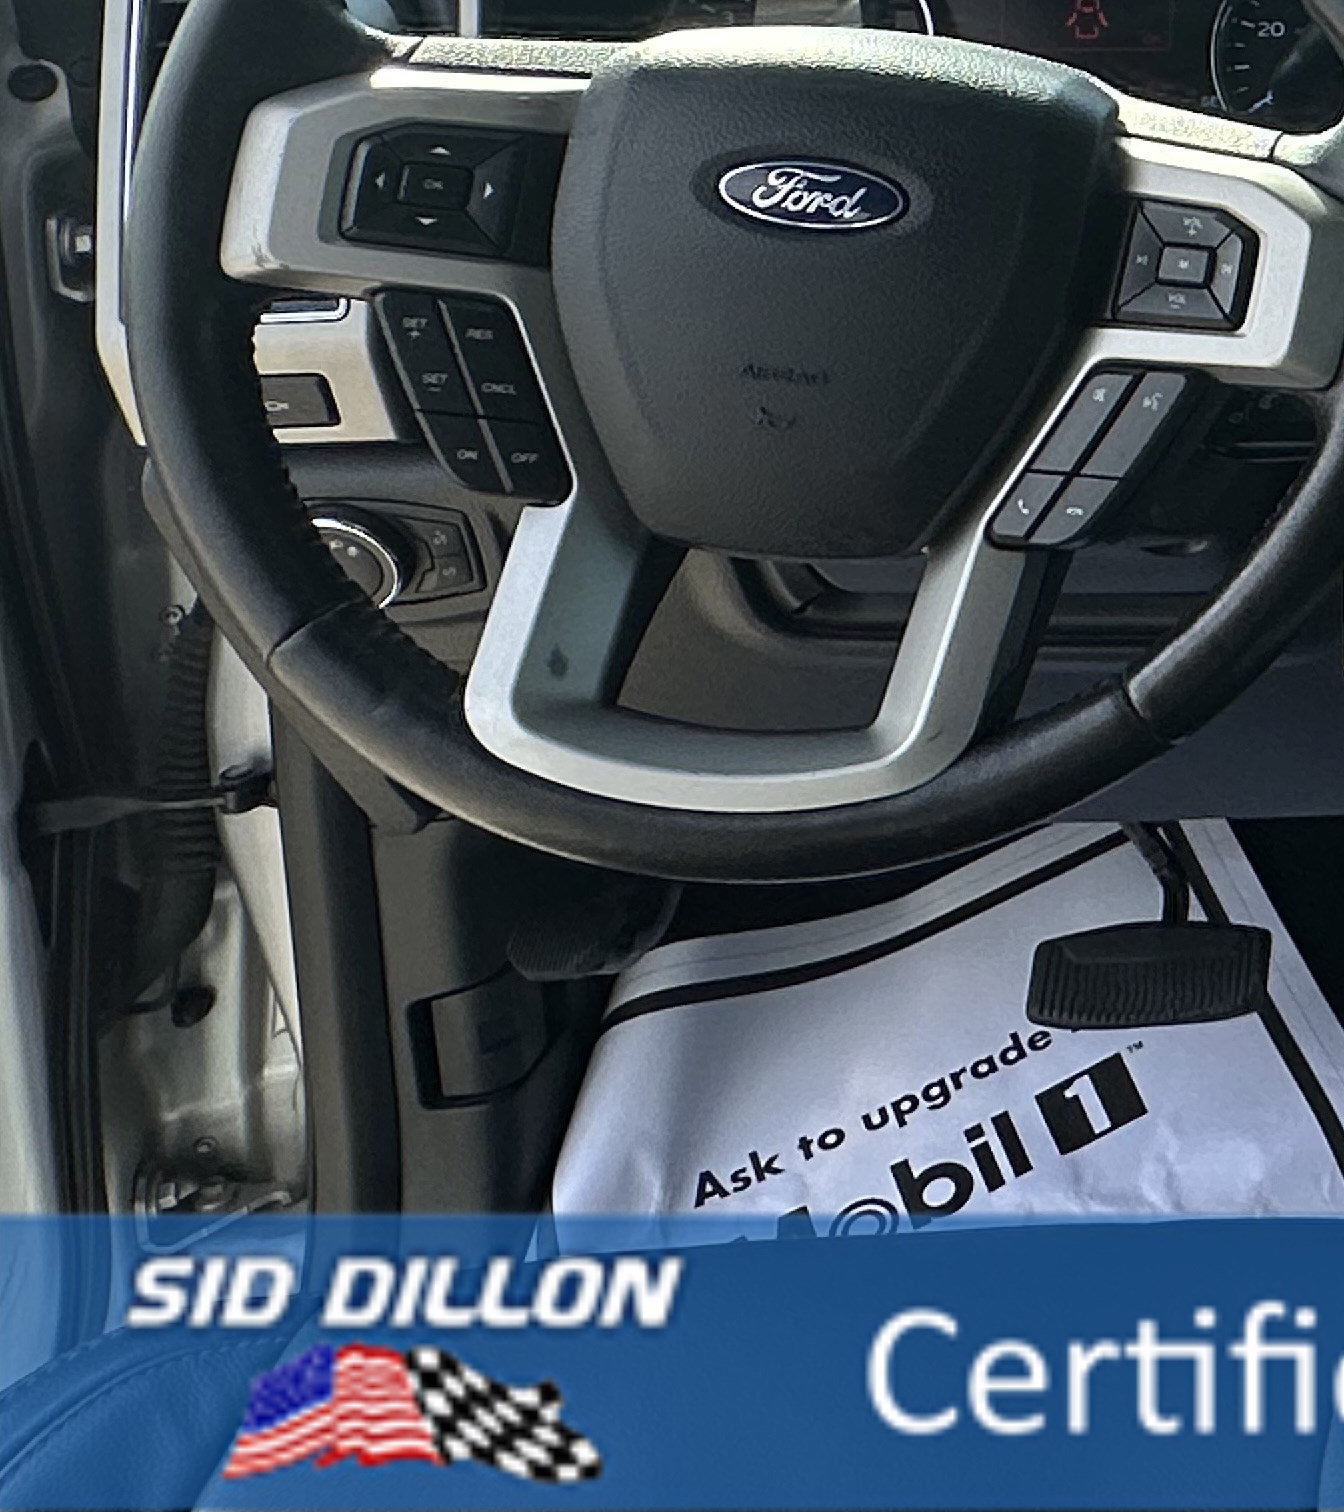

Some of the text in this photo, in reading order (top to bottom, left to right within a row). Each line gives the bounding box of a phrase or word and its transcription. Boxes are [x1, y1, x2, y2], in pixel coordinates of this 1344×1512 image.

[1257, 20, 1286, 38] 20
[752, 167, 867, 219] Ford
[402, 317, 428, 328] SET
[422, 372, 449, 385] SET
[481, 382, 516, 396] CNCL
[457, 449, 479, 461] ON
[511, 451, 539, 464] OFF
[693, 1030, 1053, 1210] Ask to upgrade
[728, 1110, 1034, 1242] obil
